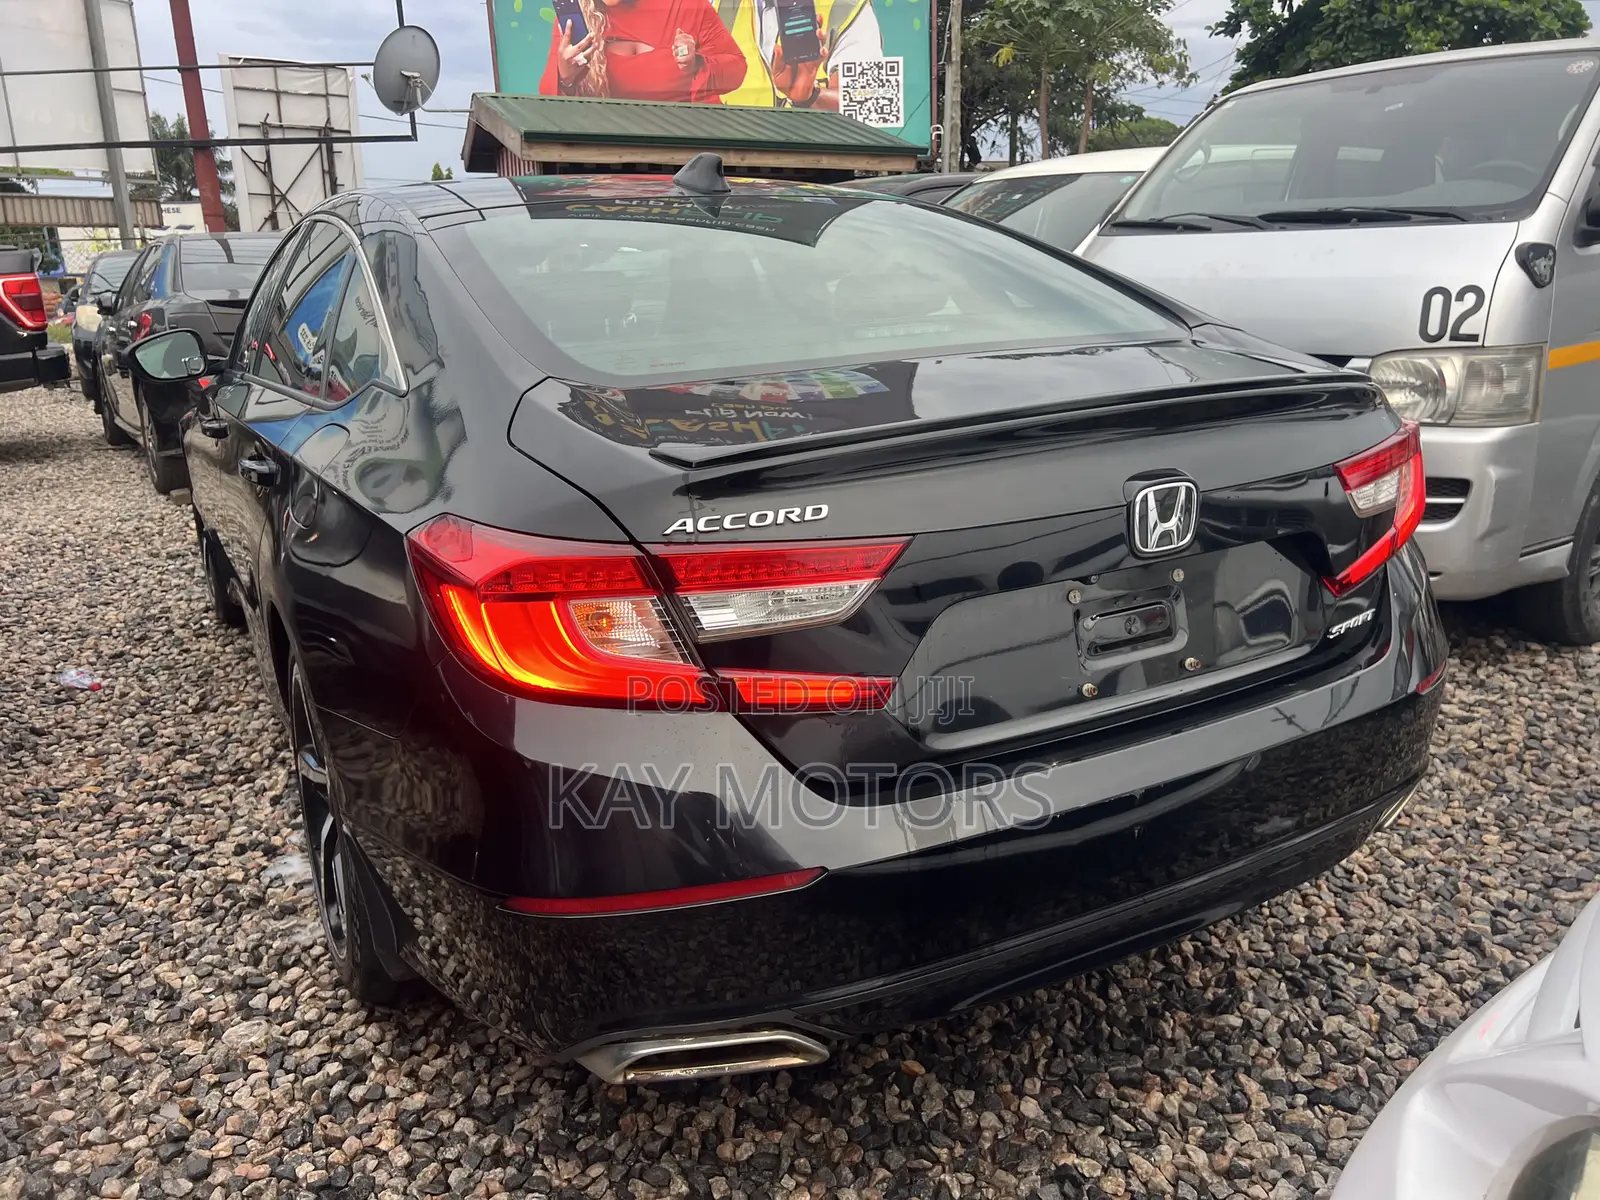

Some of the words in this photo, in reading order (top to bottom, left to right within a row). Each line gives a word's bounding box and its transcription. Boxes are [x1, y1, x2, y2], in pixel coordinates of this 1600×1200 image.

[1419, 285, 1485, 343] 02
[662, 504, 829, 536] ACCORD
[1327, 608, 1376, 639] SPORT
